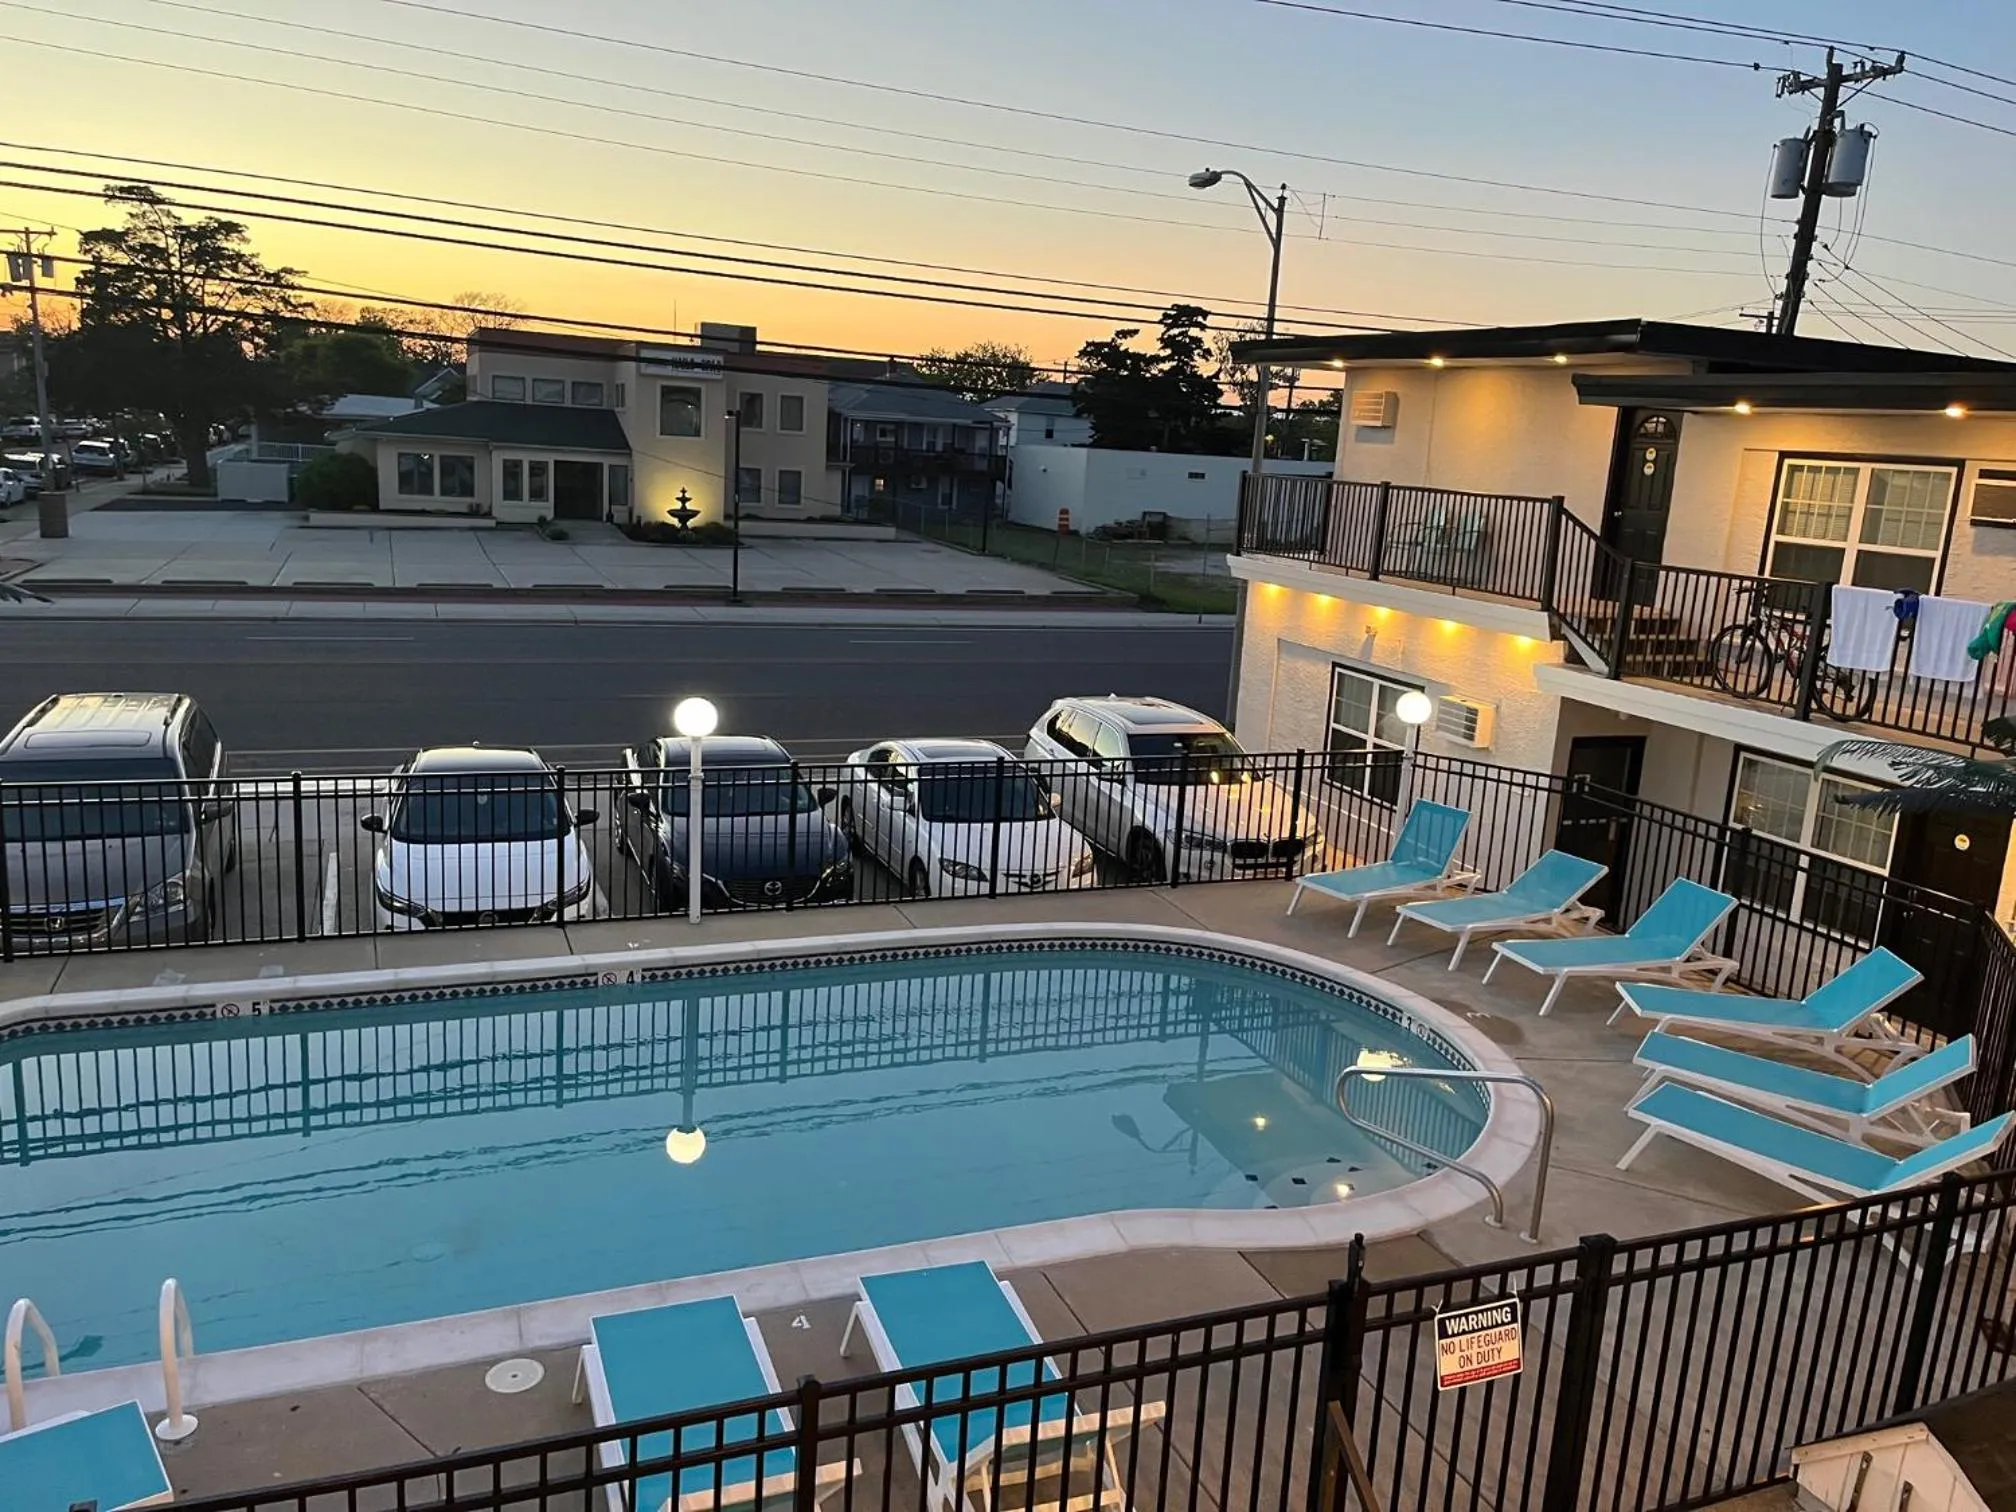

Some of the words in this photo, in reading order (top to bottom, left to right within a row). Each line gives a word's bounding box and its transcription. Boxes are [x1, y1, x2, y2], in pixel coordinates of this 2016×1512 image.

[252, 1002, 262, 1016] 5
[791, 1314, 812, 1329] 4
[1445, 1306, 1512, 1336] WARNING
[1441, 1341, 1455, 1357] NO
[1459, 1327, 1517, 1353] LIFEGUARD
[1458, 1354, 1473, 1369] ON
[1476, 1347, 1502, 1365] DUTY
